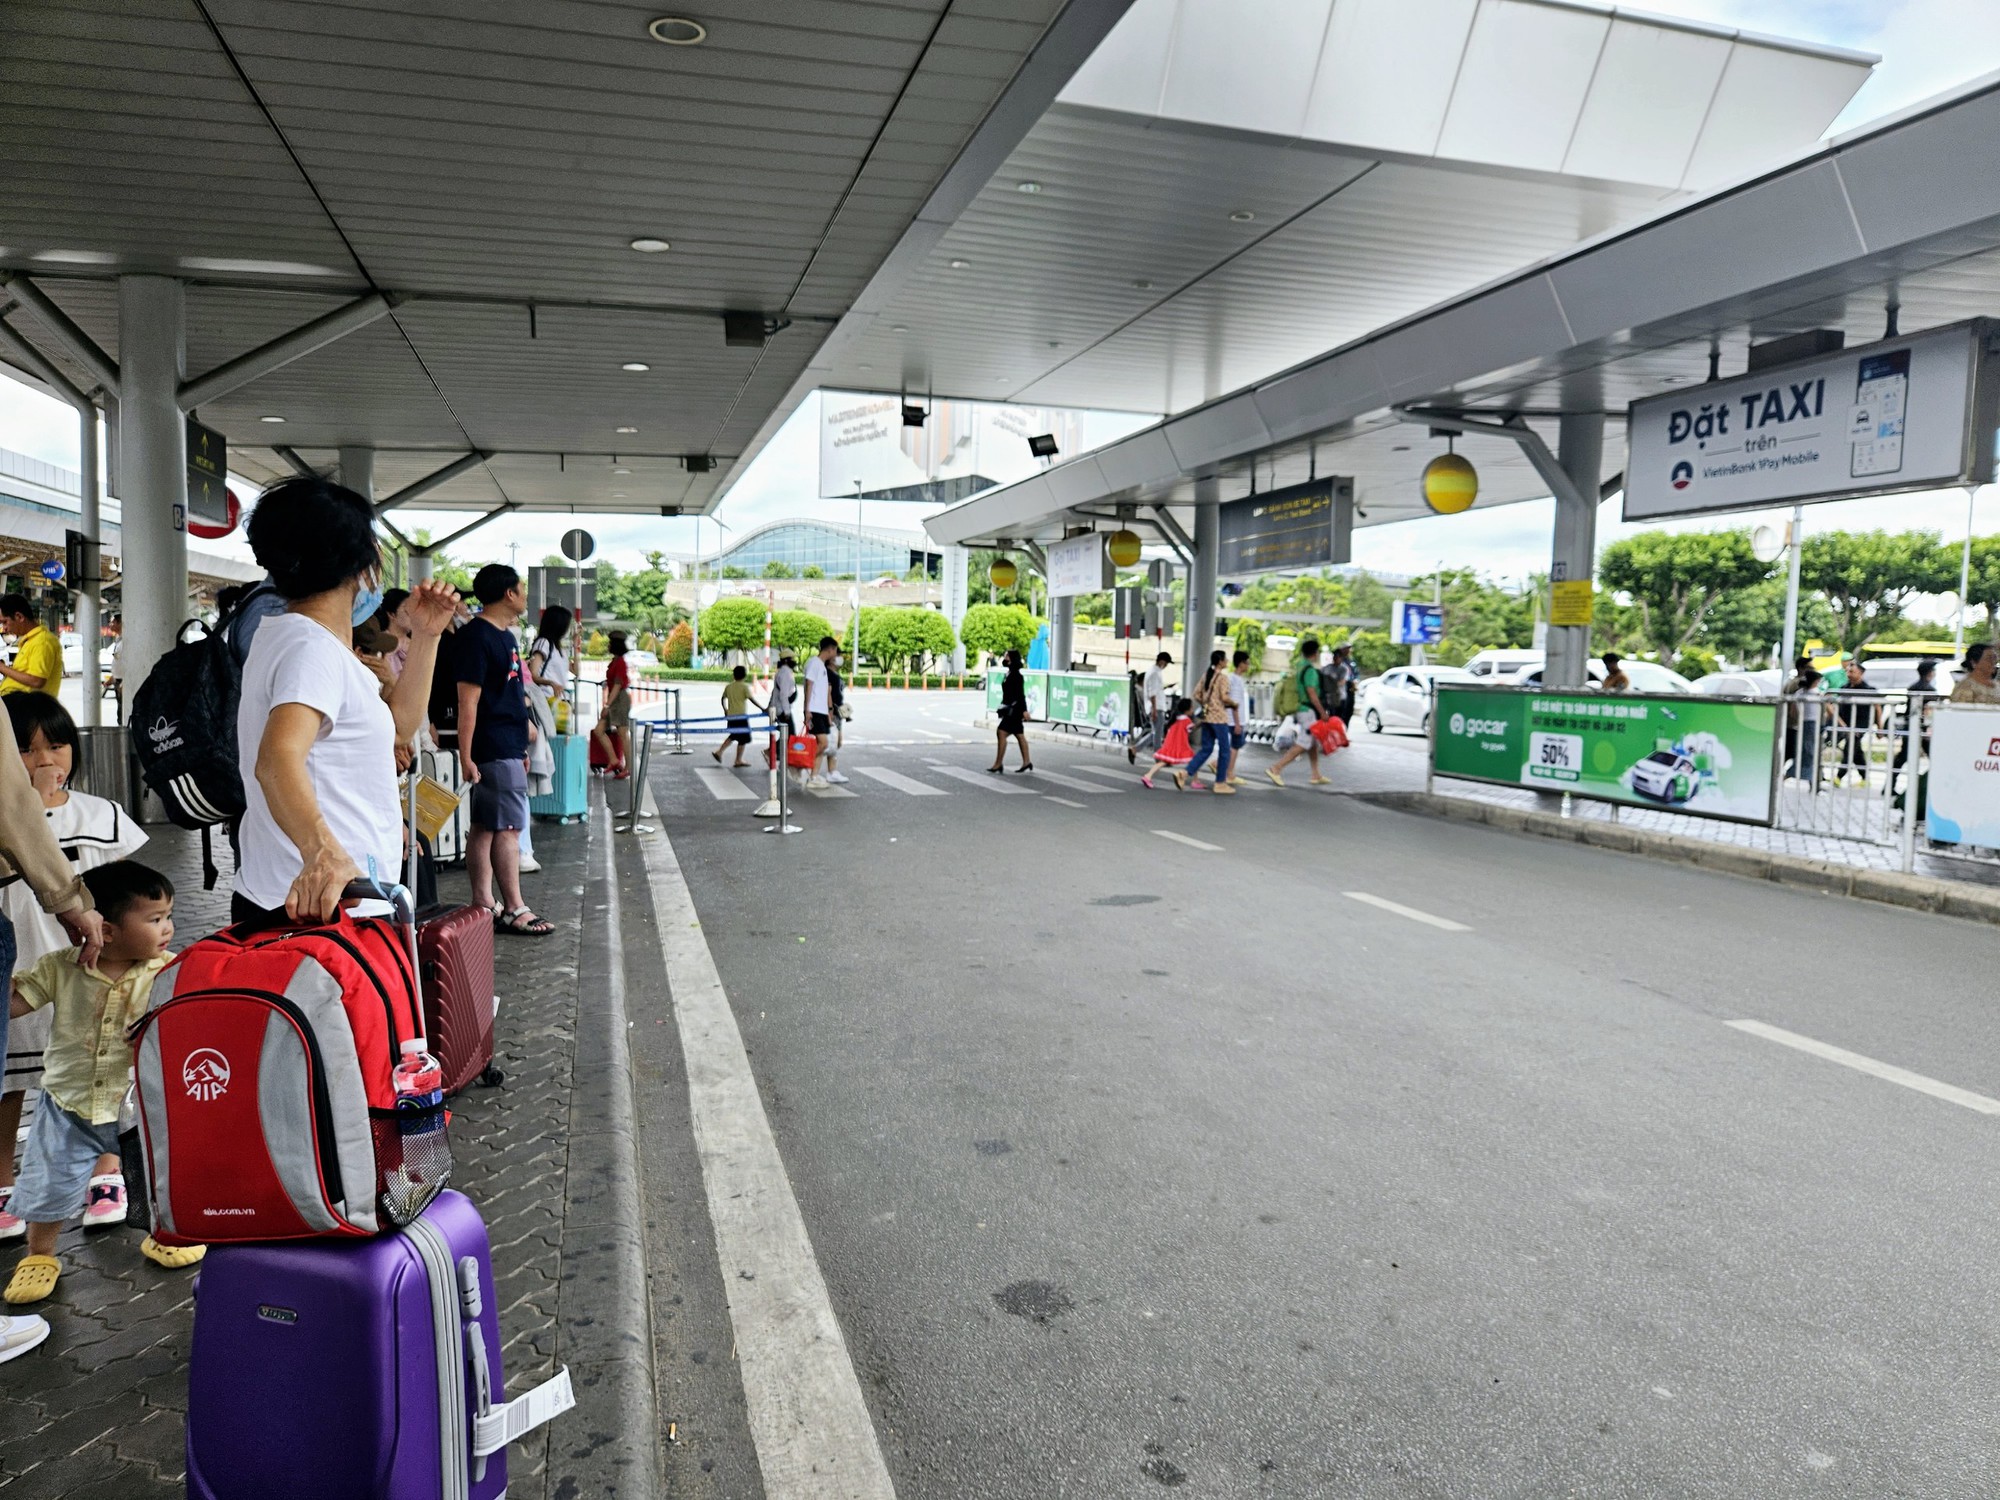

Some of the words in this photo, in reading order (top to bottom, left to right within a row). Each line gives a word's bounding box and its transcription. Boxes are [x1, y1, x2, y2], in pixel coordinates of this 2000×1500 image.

[1669, 403, 1730, 449] Đặt
[1740, 378, 1825, 430] TAXI
[1745, 434, 1778, 453] trên
[1703, 461, 1757, 479] VietinBank
[1781, 449, 1819, 467] Mobile
[1466, 718, 1508, 738] gocar
[153, 737, 184, 754] adidas
[1541, 744, 1569, 767] 50%
[186, 1081, 228, 1102] AIA
